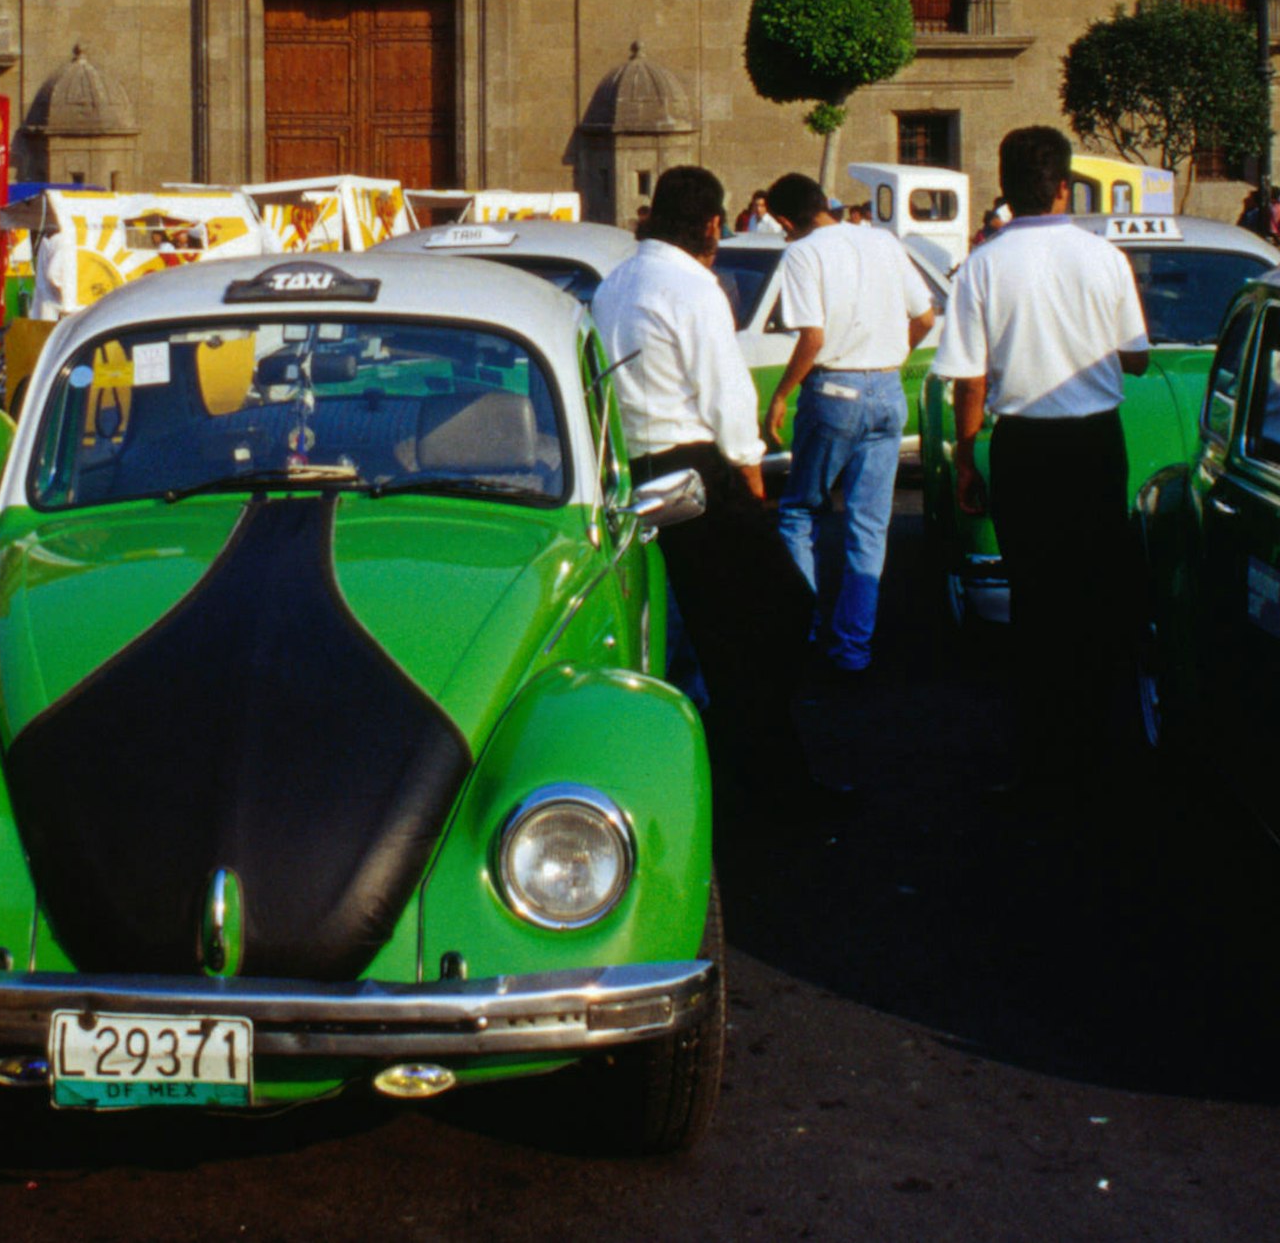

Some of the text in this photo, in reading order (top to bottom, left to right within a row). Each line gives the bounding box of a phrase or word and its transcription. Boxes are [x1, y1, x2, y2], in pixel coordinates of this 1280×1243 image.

[1113, 220, 1167, 234] TAXI
[452, 229, 483, 241] TAXI
[272, 271, 334, 290] TAXI
[107, 1082, 196, 1098] DF MEX
